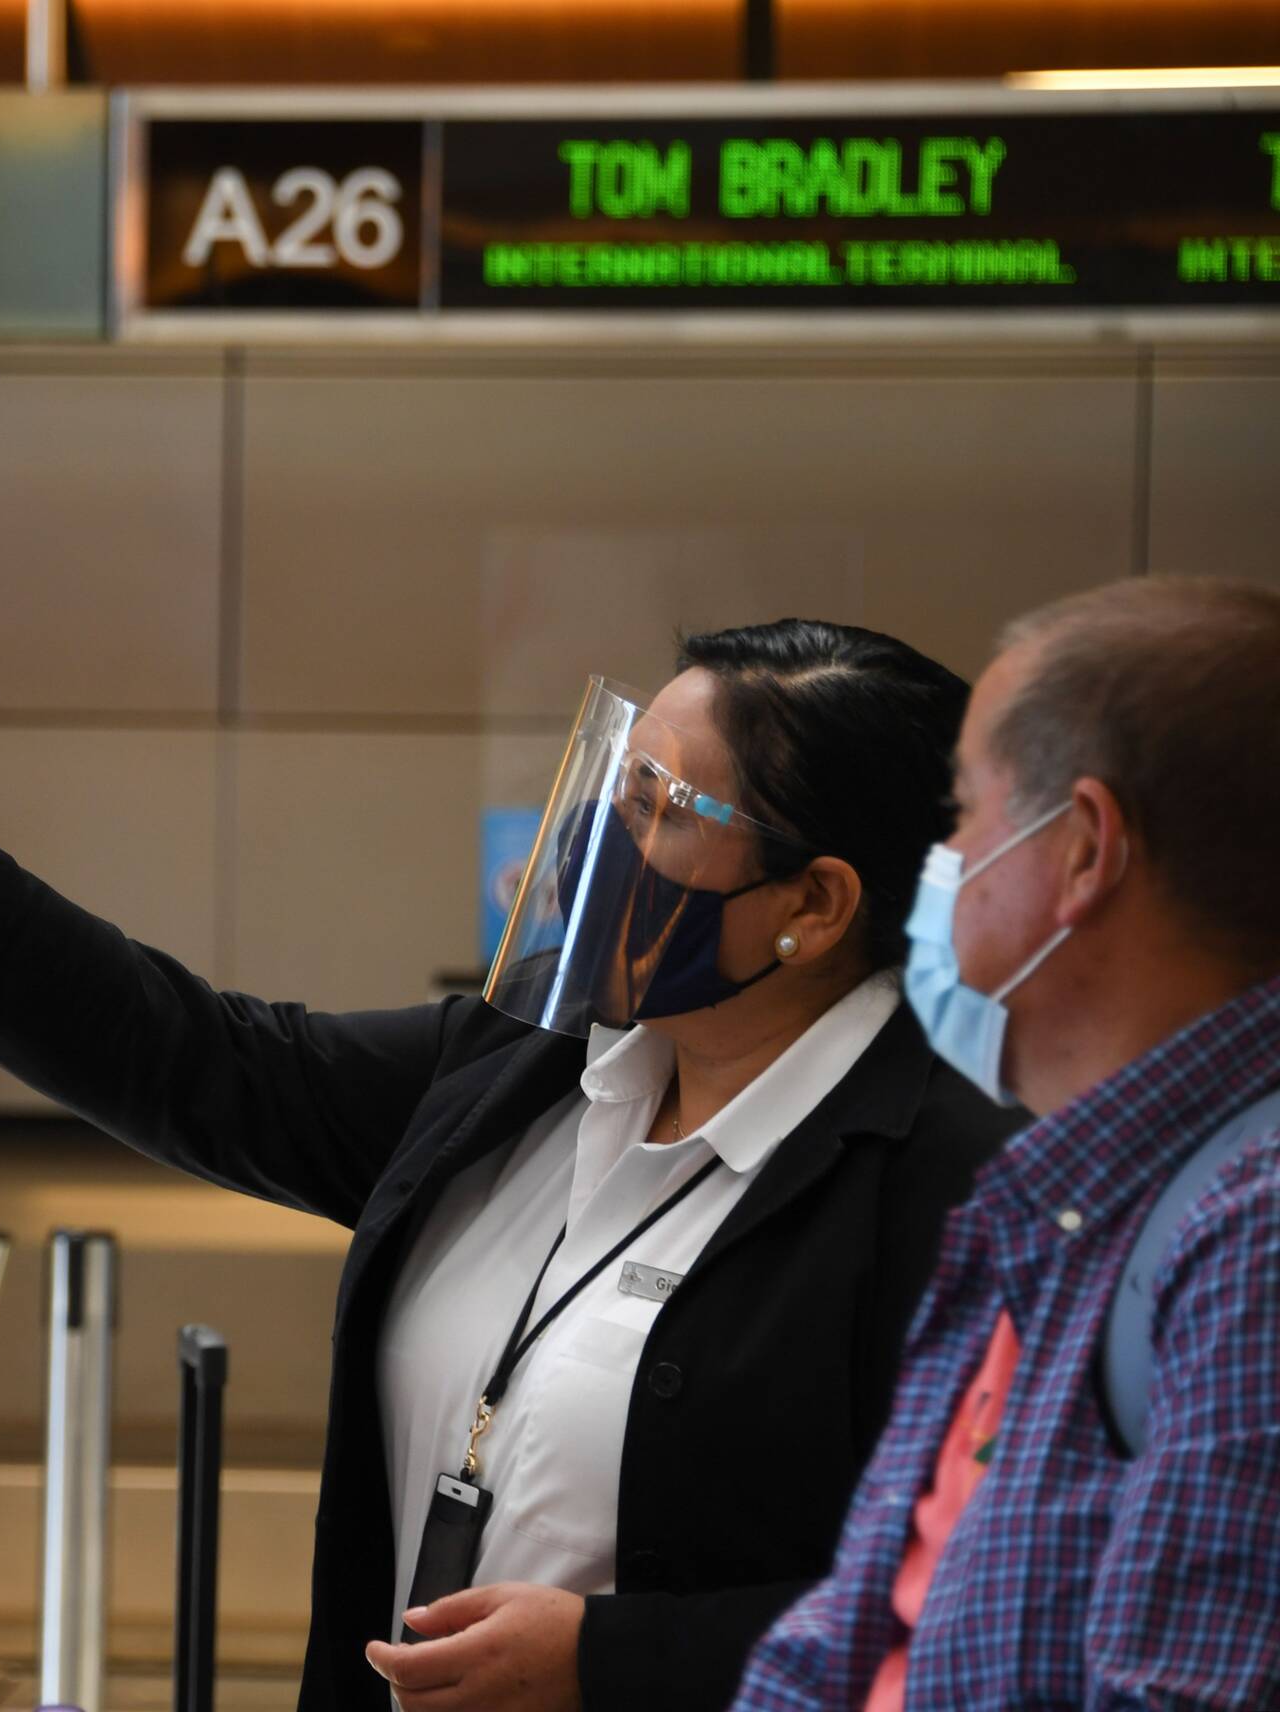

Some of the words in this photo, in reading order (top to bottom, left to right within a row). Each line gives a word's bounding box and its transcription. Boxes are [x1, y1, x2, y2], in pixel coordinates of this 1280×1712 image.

[183, 166, 403, 268] A26
[559, 140, 692, 219] TOM
[719, 137, 1006, 218] BRADLEY
[483, 240, 842, 288] INTERNATIONAL
[844, 239, 1076, 286] TERMINAL
